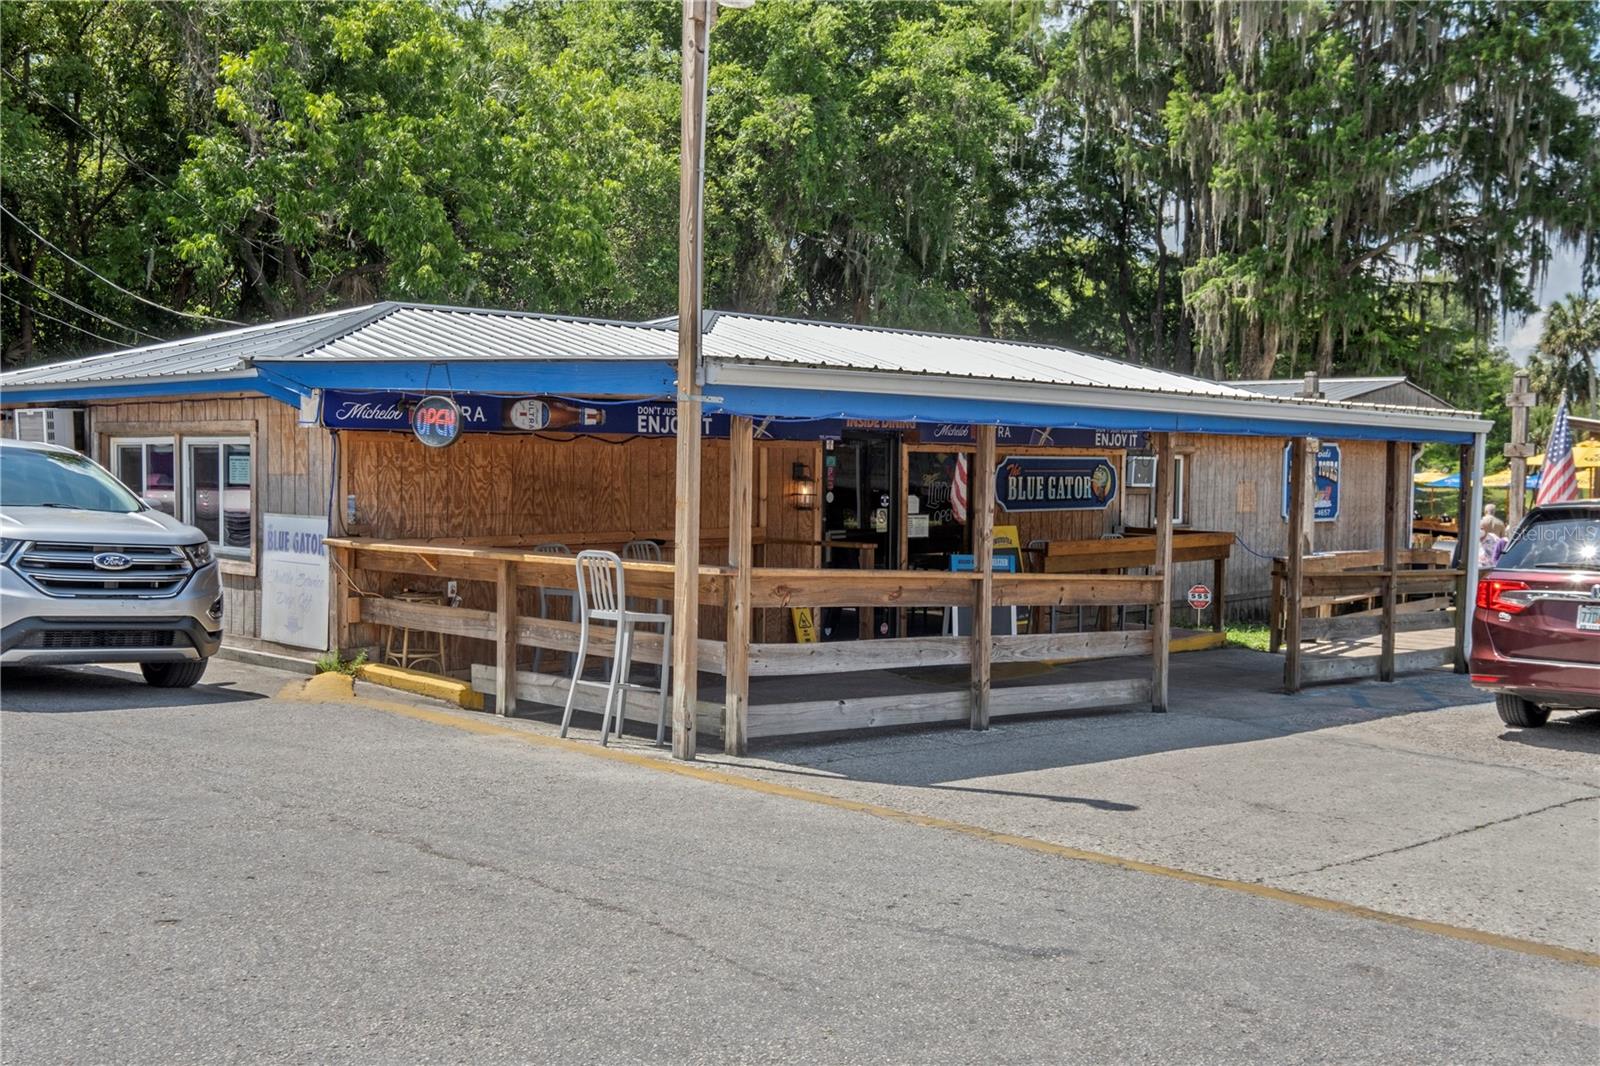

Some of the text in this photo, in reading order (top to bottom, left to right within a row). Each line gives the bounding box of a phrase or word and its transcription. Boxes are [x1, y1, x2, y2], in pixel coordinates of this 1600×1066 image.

[637, 406, 661, 415] DON'T
[416, 408, 456, 437] OPEN
[637, 415, 678, 434] ENJO
[934, 423, 969, 438] Michelob
[1095, 432, 1138, 447] ENJOY IT
[1006, 464, 1022, 477] The
[1008, 475, 1093, 500] BLUE GATOR
[267, 530, 325, 556] BLUE GATOR
